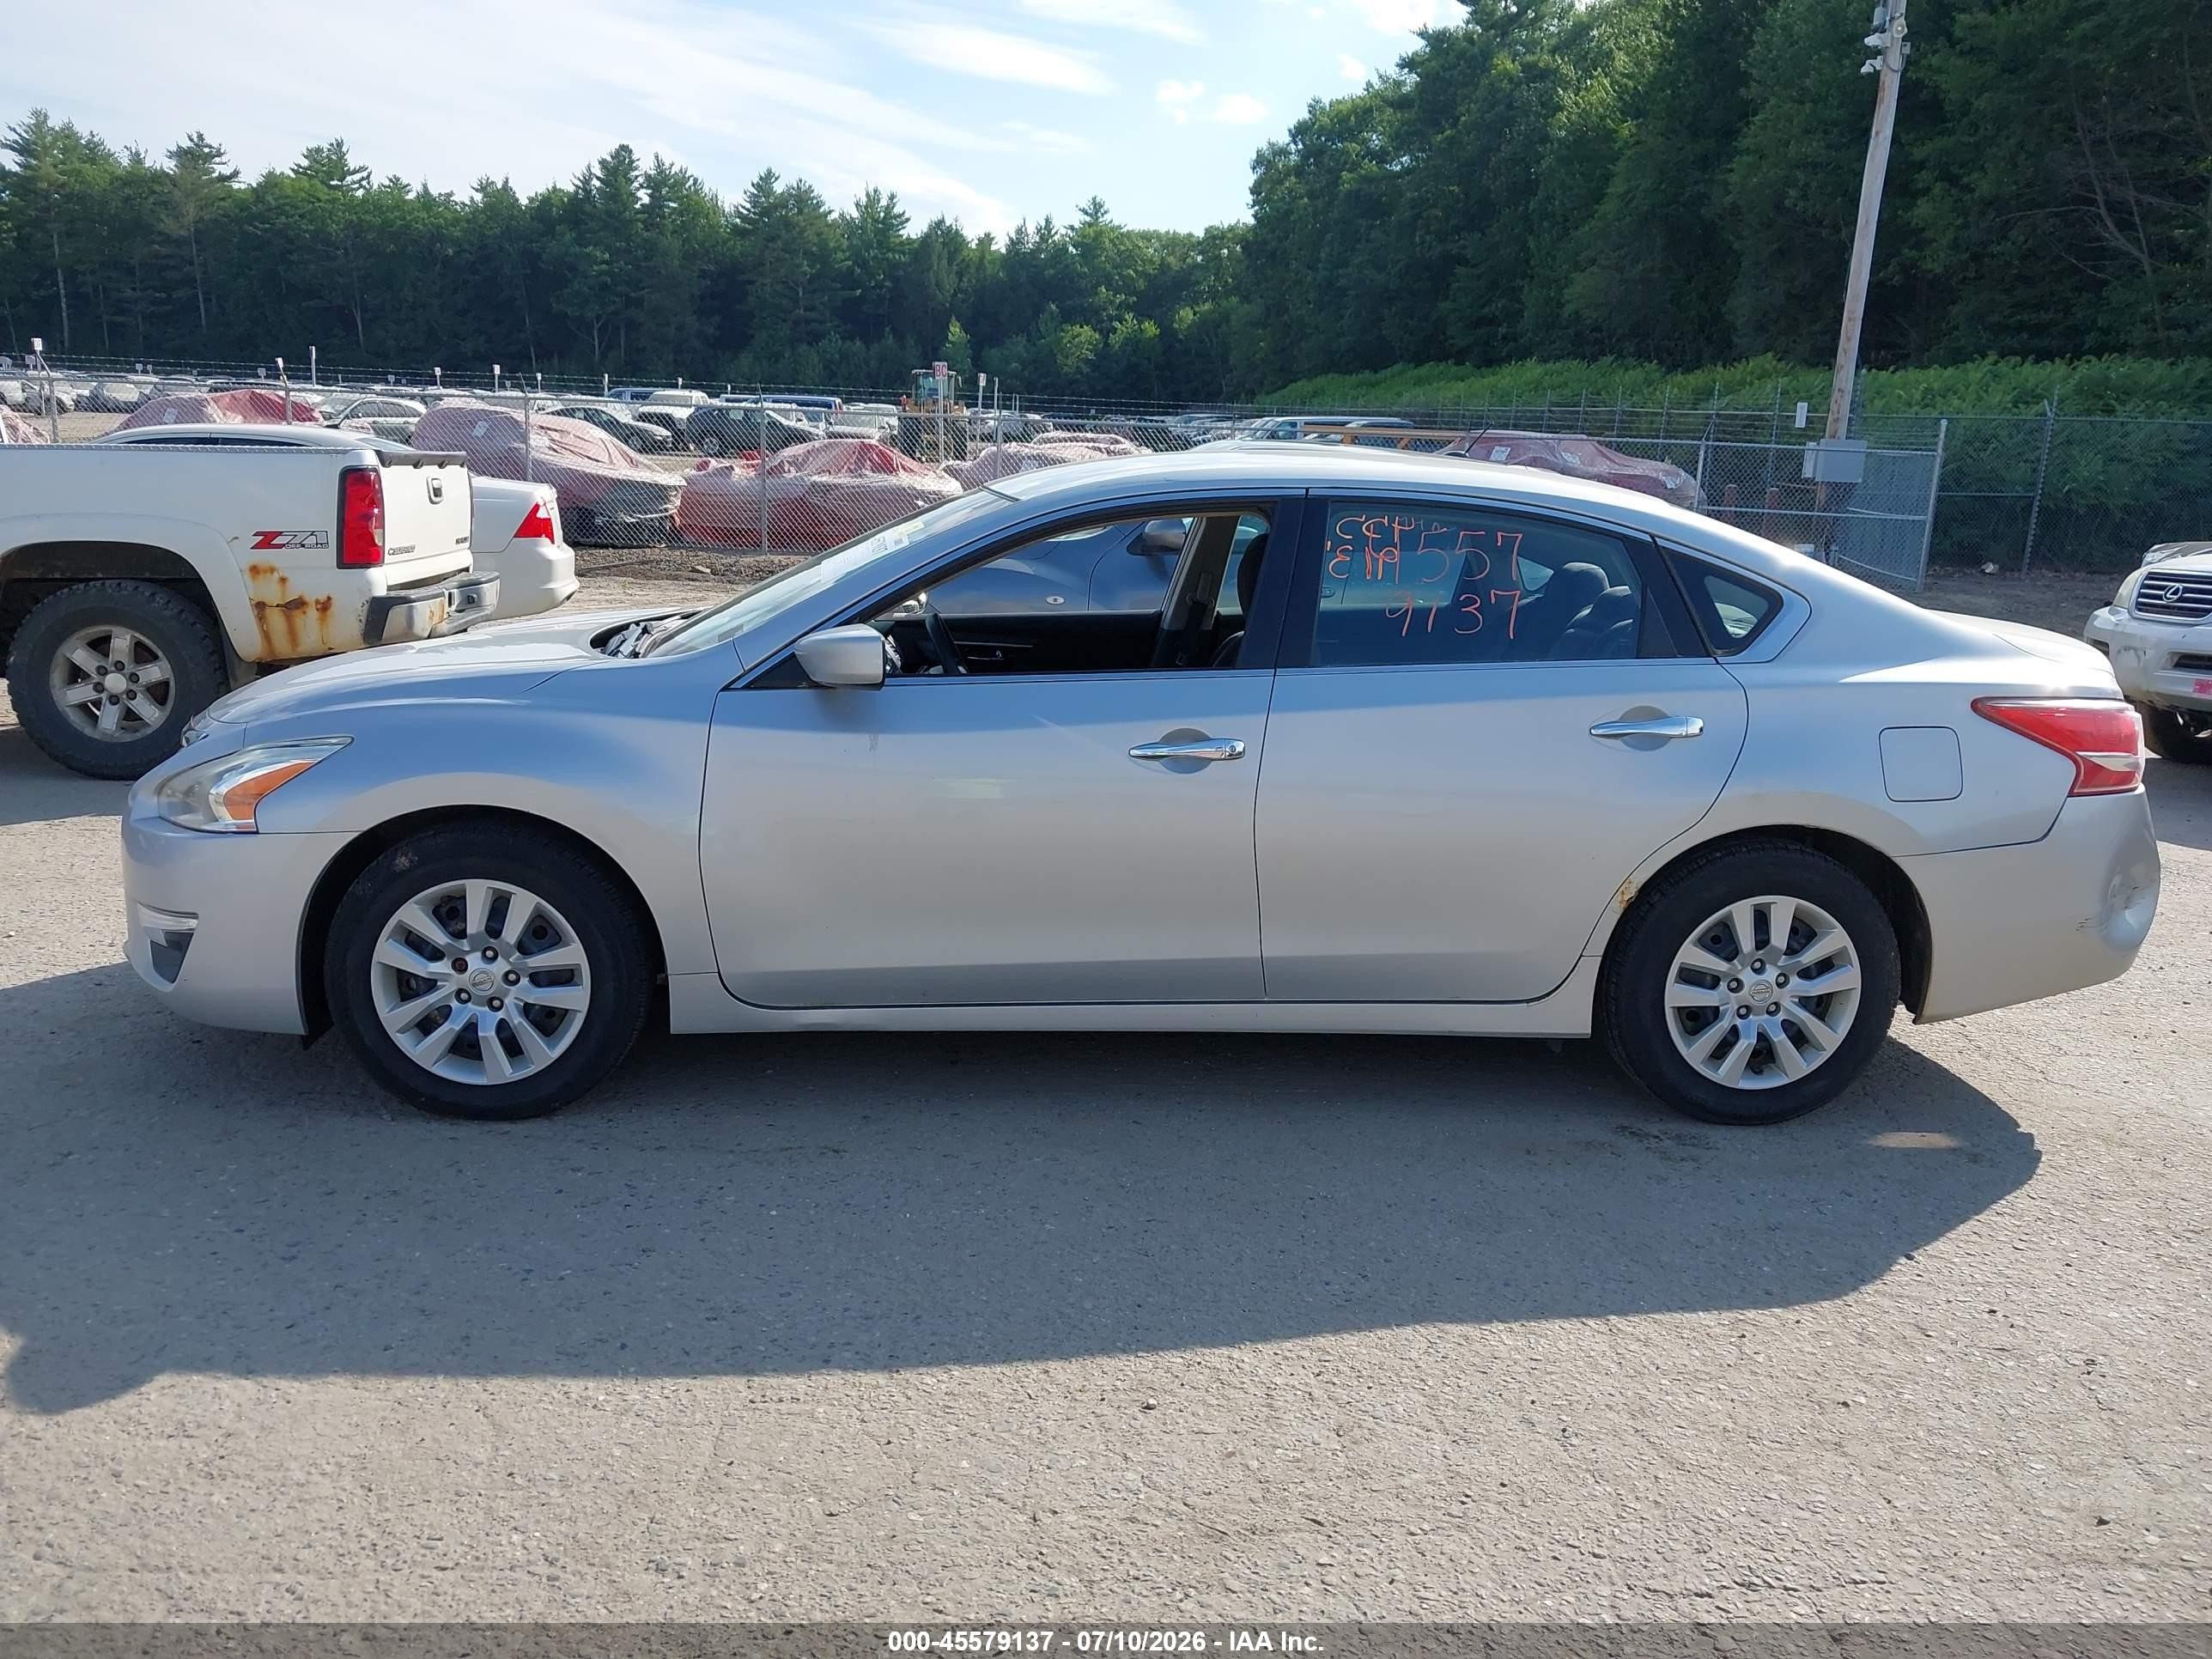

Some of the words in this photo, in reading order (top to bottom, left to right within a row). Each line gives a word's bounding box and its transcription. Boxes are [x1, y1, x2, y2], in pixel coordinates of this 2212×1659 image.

[935, 364, 947, 377] BC
[250, 531, 329, 550] Z71
[1386, 589, 1521, 640] 9137
